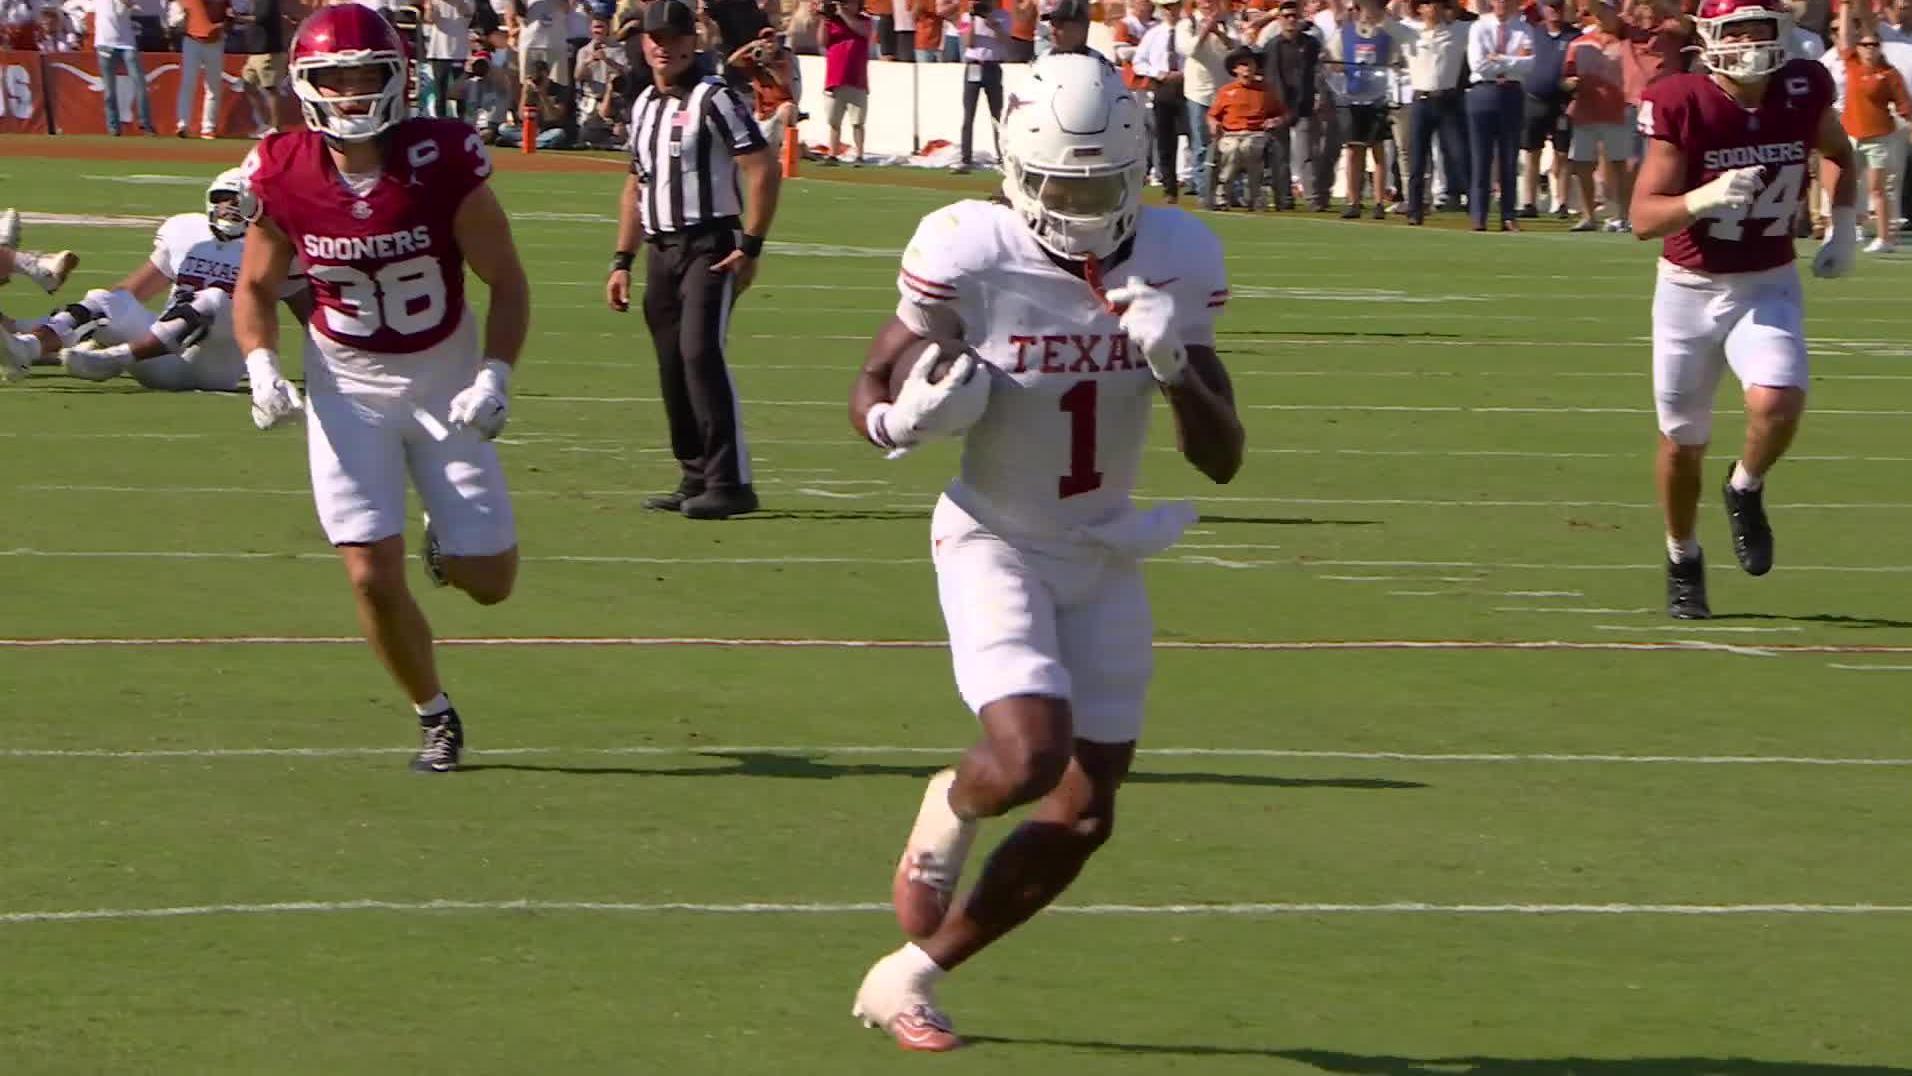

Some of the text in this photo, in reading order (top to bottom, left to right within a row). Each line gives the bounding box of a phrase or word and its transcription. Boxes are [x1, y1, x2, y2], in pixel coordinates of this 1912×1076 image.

[1704, 141, 1804, 169] SOONERS
[303, 225, 432, 261] SOONERS
[307, 255, 447, 337] 38
[1059, 380, 1104, 499] 1
